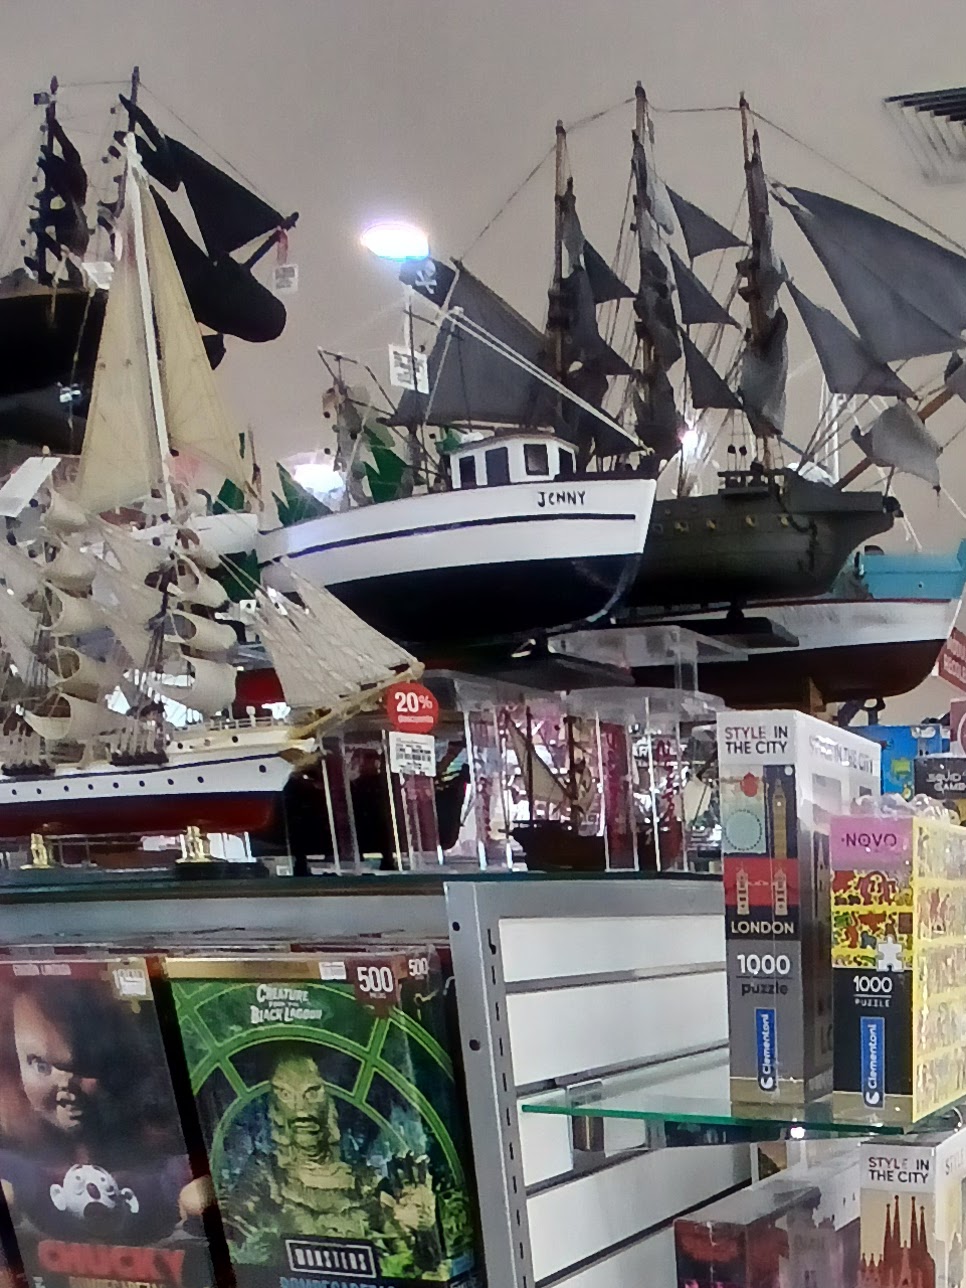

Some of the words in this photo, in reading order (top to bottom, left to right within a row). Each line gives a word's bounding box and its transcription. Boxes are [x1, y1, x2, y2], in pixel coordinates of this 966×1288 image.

[394, 691, 433, 713] 20%
[724, 726, 766, 740] STYLE
[773, 725, 788, 739] IN
[725, 741, 751, 755] THE
[755, 741, 788, 755] CITY
[730, 920, 795, 935] LONDON
[408, 957, 429, 977] 500
[736, 953, 791, 975] 1000
[356, 966, 394, 993] 500
[741, 980, 789, 997] puzzle
[852, 975, 893, 993] 1000
[760, 1013, 771, 1075] Clementoni
[867, 1023, 878, 1090] Clementoni
[868, 1156, 908, 1170] STYLE
[916, 1159, 930, 1171] IN
[869, 1169, 894, 1182] THE
[897, 1171, 929, 1184] CITY
